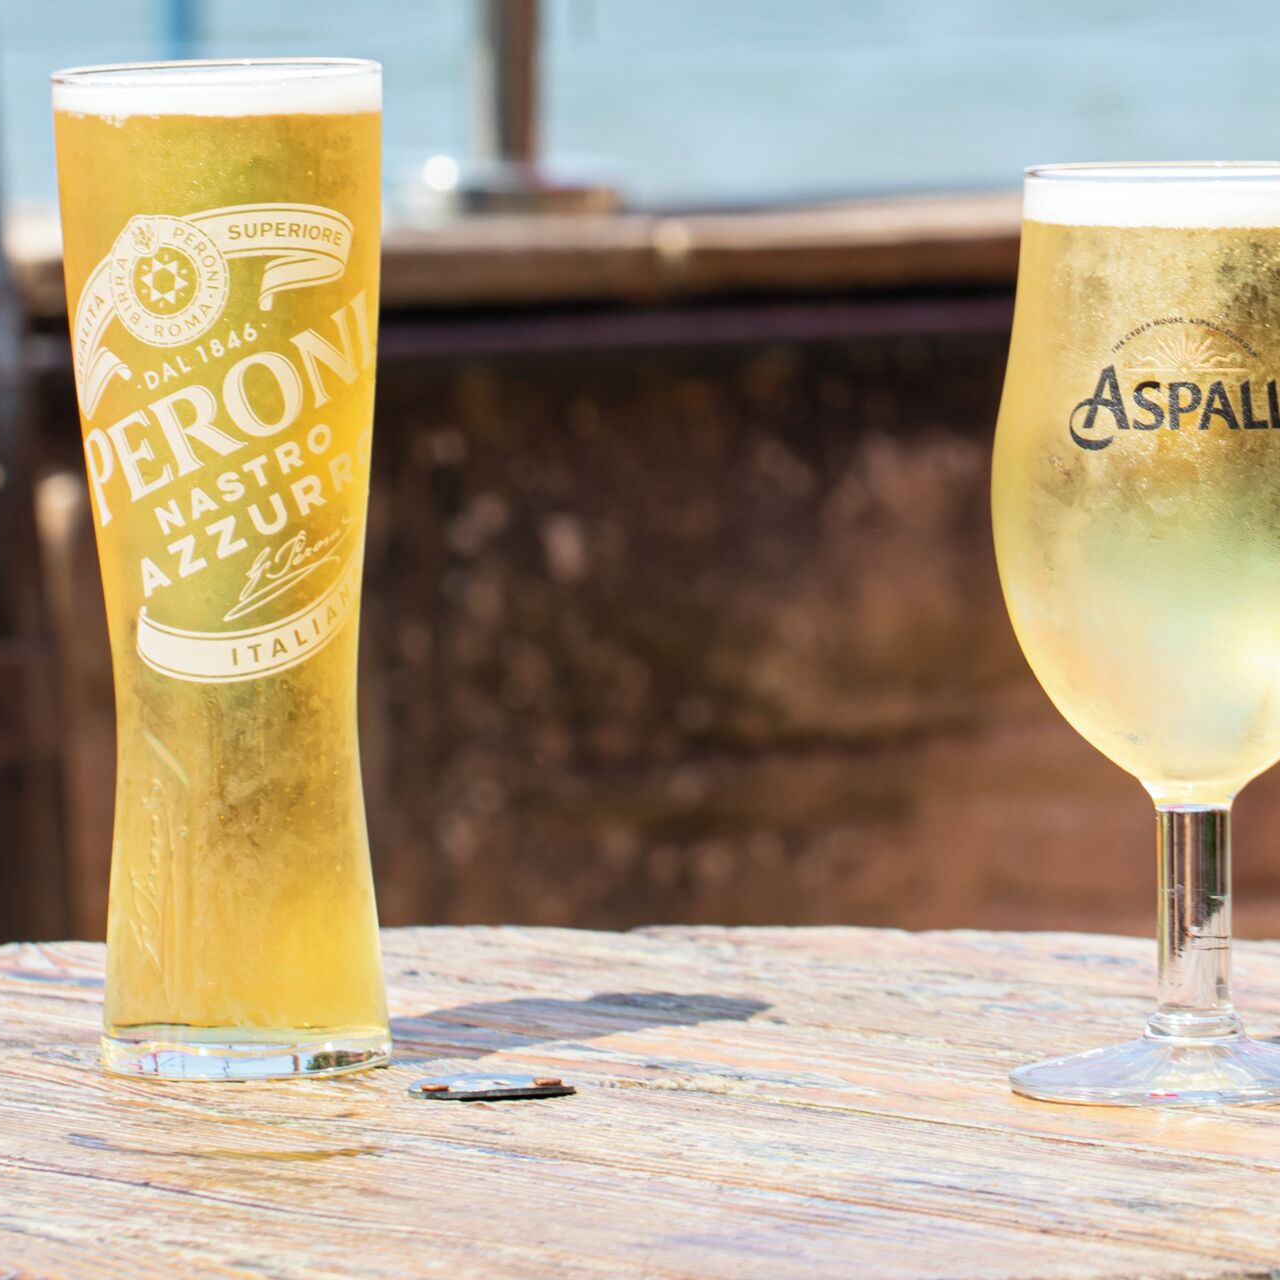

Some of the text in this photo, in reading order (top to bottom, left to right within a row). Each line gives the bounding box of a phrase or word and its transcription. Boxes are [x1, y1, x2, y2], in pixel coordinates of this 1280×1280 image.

[173, 227, 219, 290] PERONI
[228, 222, 343, 247] SUPERIORE
[115, 258, 141, 325] BIRRA
[154, 303, 212, 337] ROMA
[143, 323, 257, 390] DAL 1846
[84, 288, 372, 528] PERONI
[153, 423, 332, 535] NASTRO
